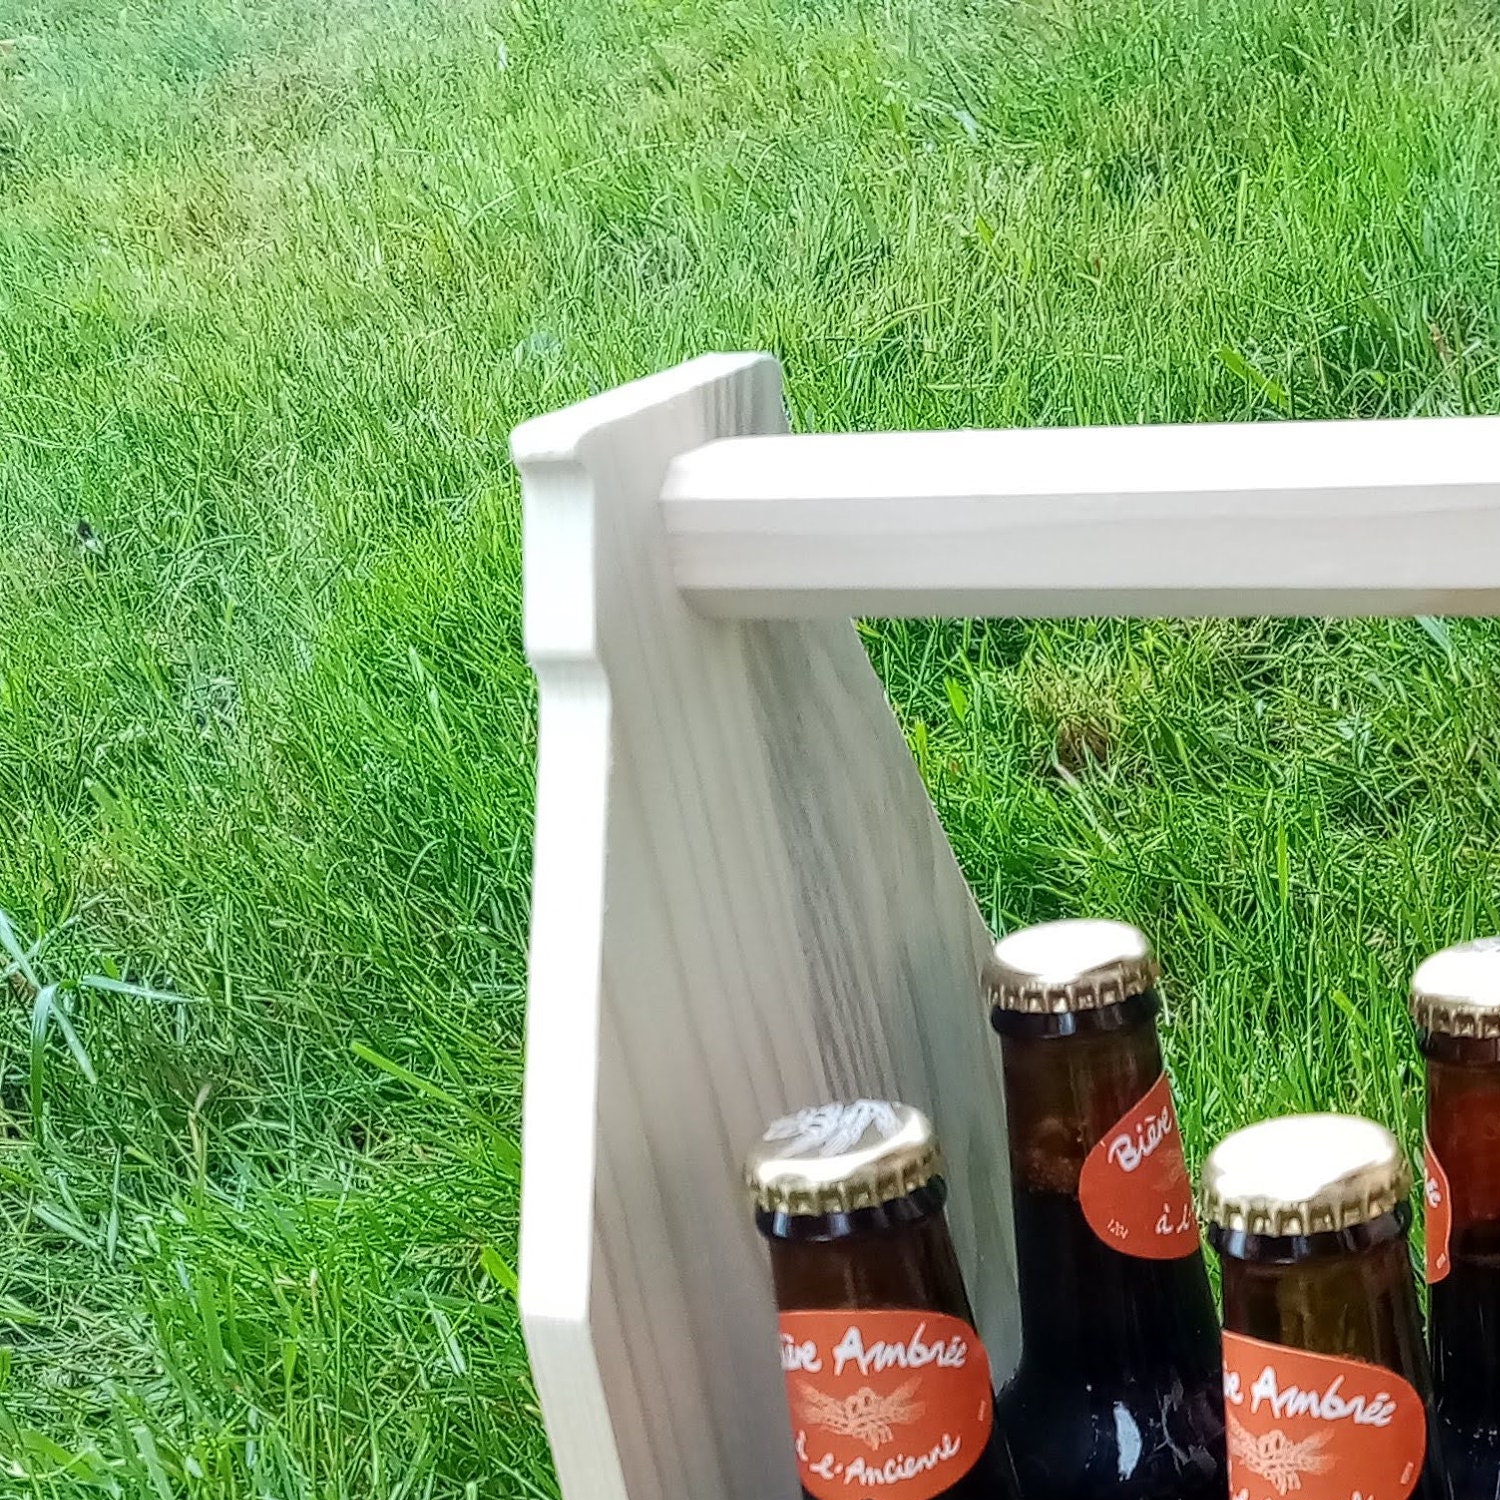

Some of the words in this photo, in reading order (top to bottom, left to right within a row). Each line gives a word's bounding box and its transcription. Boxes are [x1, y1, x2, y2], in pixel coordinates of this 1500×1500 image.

[1107, 1105, 1173, 1172] Bière
[833, 1322, 967, 1376] Ambrée
[1250, 1365, 1397, 1427] Ambrée
